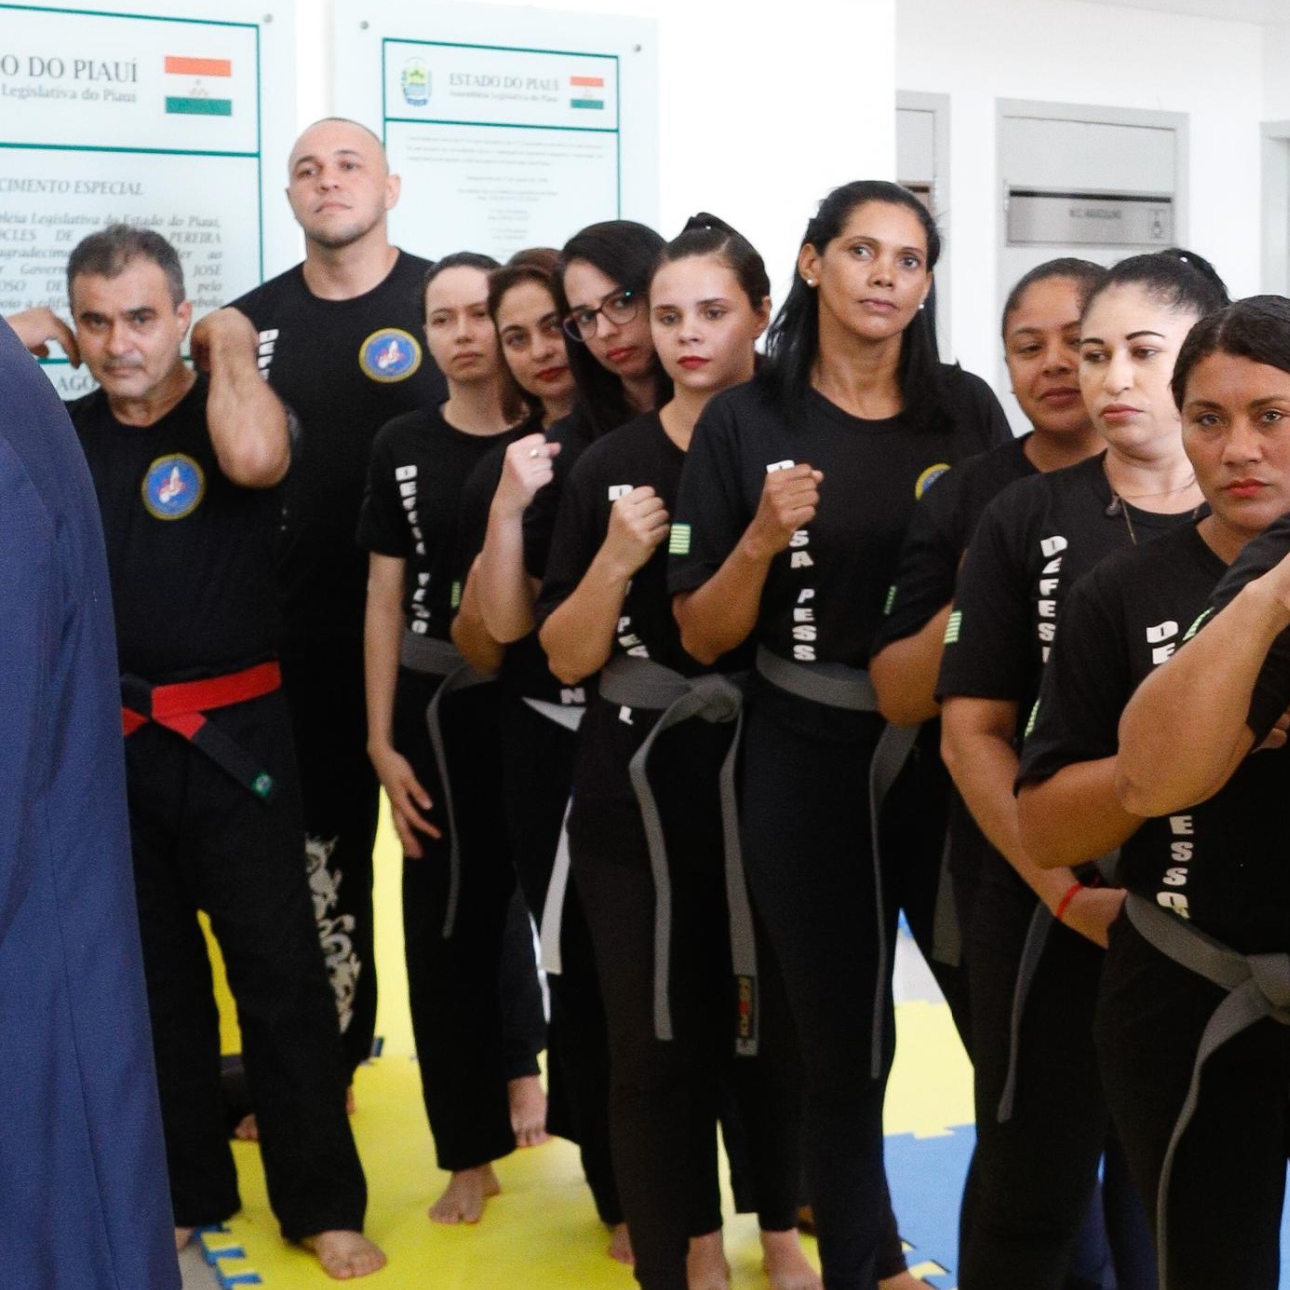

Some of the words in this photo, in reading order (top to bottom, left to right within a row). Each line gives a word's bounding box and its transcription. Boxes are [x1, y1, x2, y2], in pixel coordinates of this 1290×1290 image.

[28, 55, 65, 79] DO
[73, 57, 137, 83] PIAUÍ
[74, 180, 145, 196] ESPECIAL
